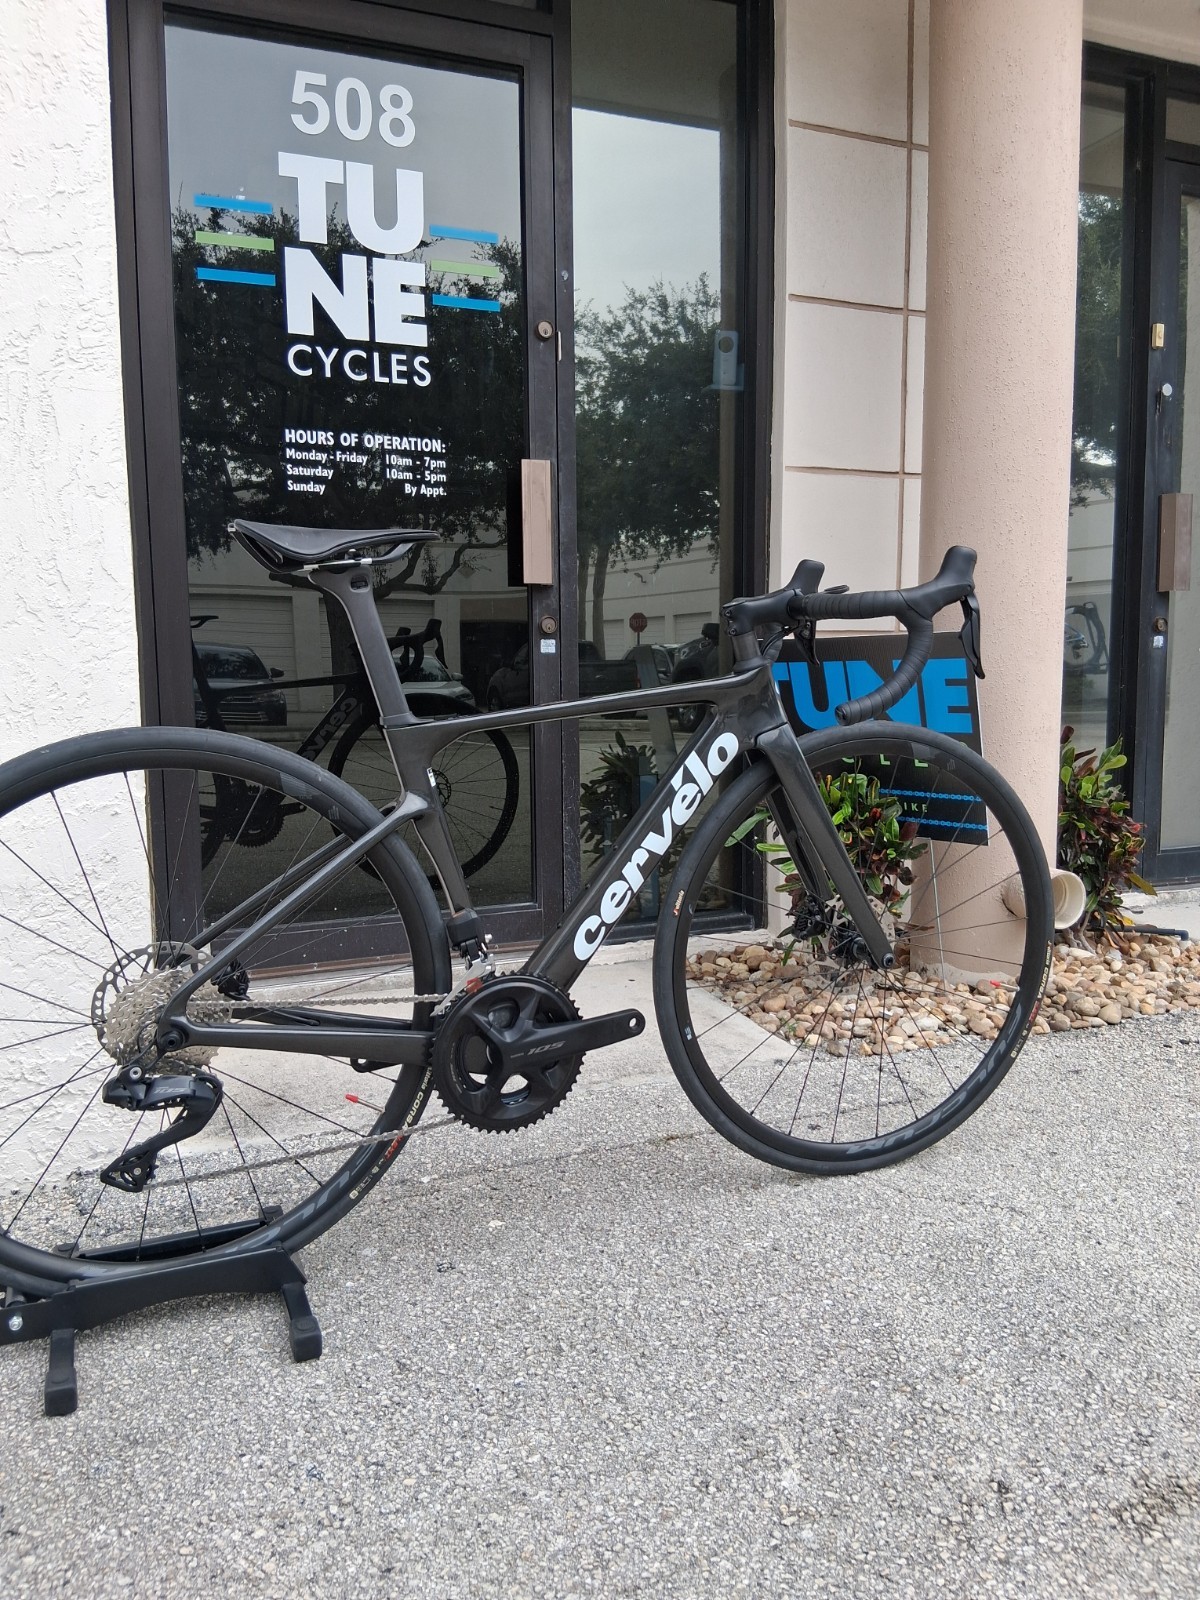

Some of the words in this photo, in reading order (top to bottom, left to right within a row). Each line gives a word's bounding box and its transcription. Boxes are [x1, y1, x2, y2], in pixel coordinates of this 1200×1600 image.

[290, 70, 416, 148] 508
[278, 151, 424, 255] TU
[284, 246, 428, 347] NE
[287, 344, 432, 387] CYCLES
[285, 429, 334, 446] HOURS
[340, 432, 359, 447] OF
[364, 434, 446, 453] OPERATION:
[286, 448, 328, 464] Monday
[336, 451, 368, 466] Friday
[385, 454, 413, 467] 10am
[424, 456, 447, 471] 7pm
[286, 464, 334, 479] Saturday
[386, 468, 413, 480] 10am
[424, 471, 447, 484] 5pm
[287, 480, 326, 495] Sunday
[404, 483, 417, 496] By
[420, 484, 447, 498] Appt.
[903, 802, 929, 813] IKE
[574, 732, 739, 961] cervélo
[527, 1040, 566, 1056] 105
